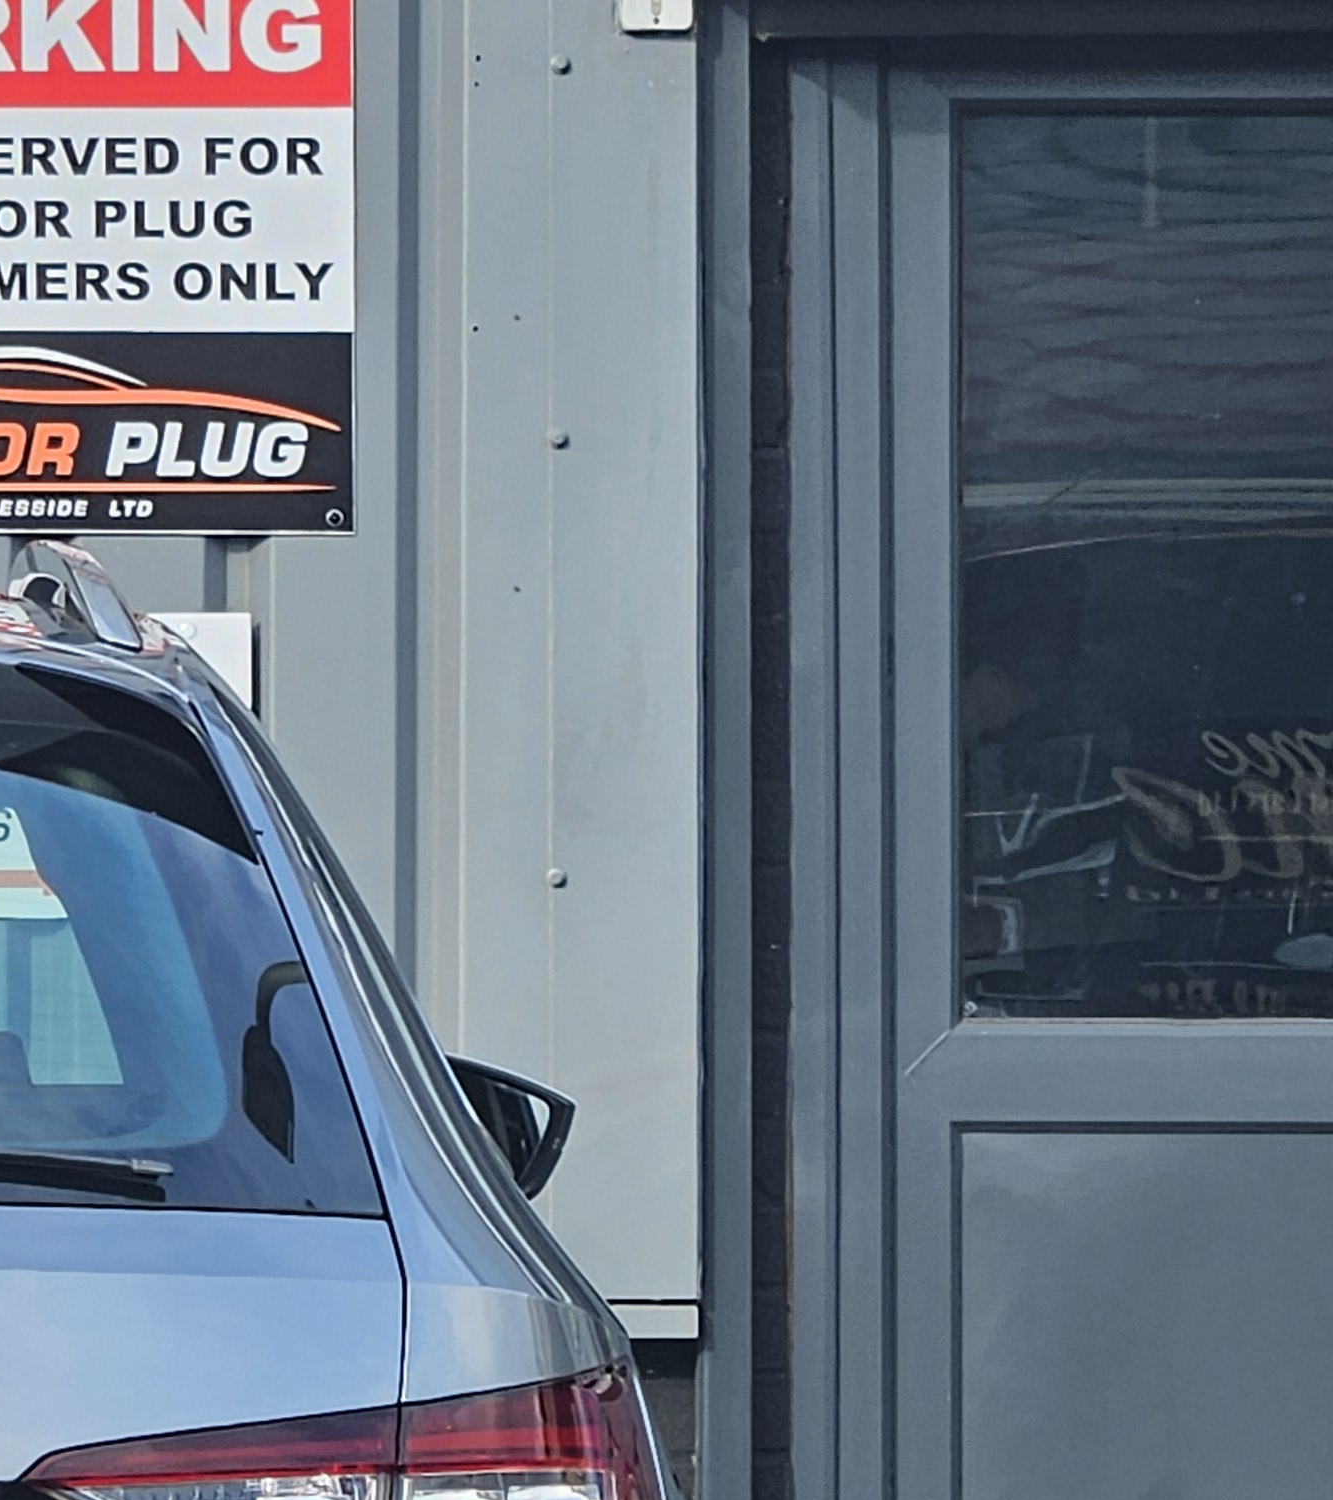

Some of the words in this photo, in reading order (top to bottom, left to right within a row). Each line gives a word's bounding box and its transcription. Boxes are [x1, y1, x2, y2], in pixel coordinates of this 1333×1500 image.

[204, 137, 323, 176] FOR
[94, 199, 254, 239] PLUG
[173, 261, 334, 302] ONLY
[104, 421, 310, 476] PLUG
[108, 499, 154, 518] LTD
